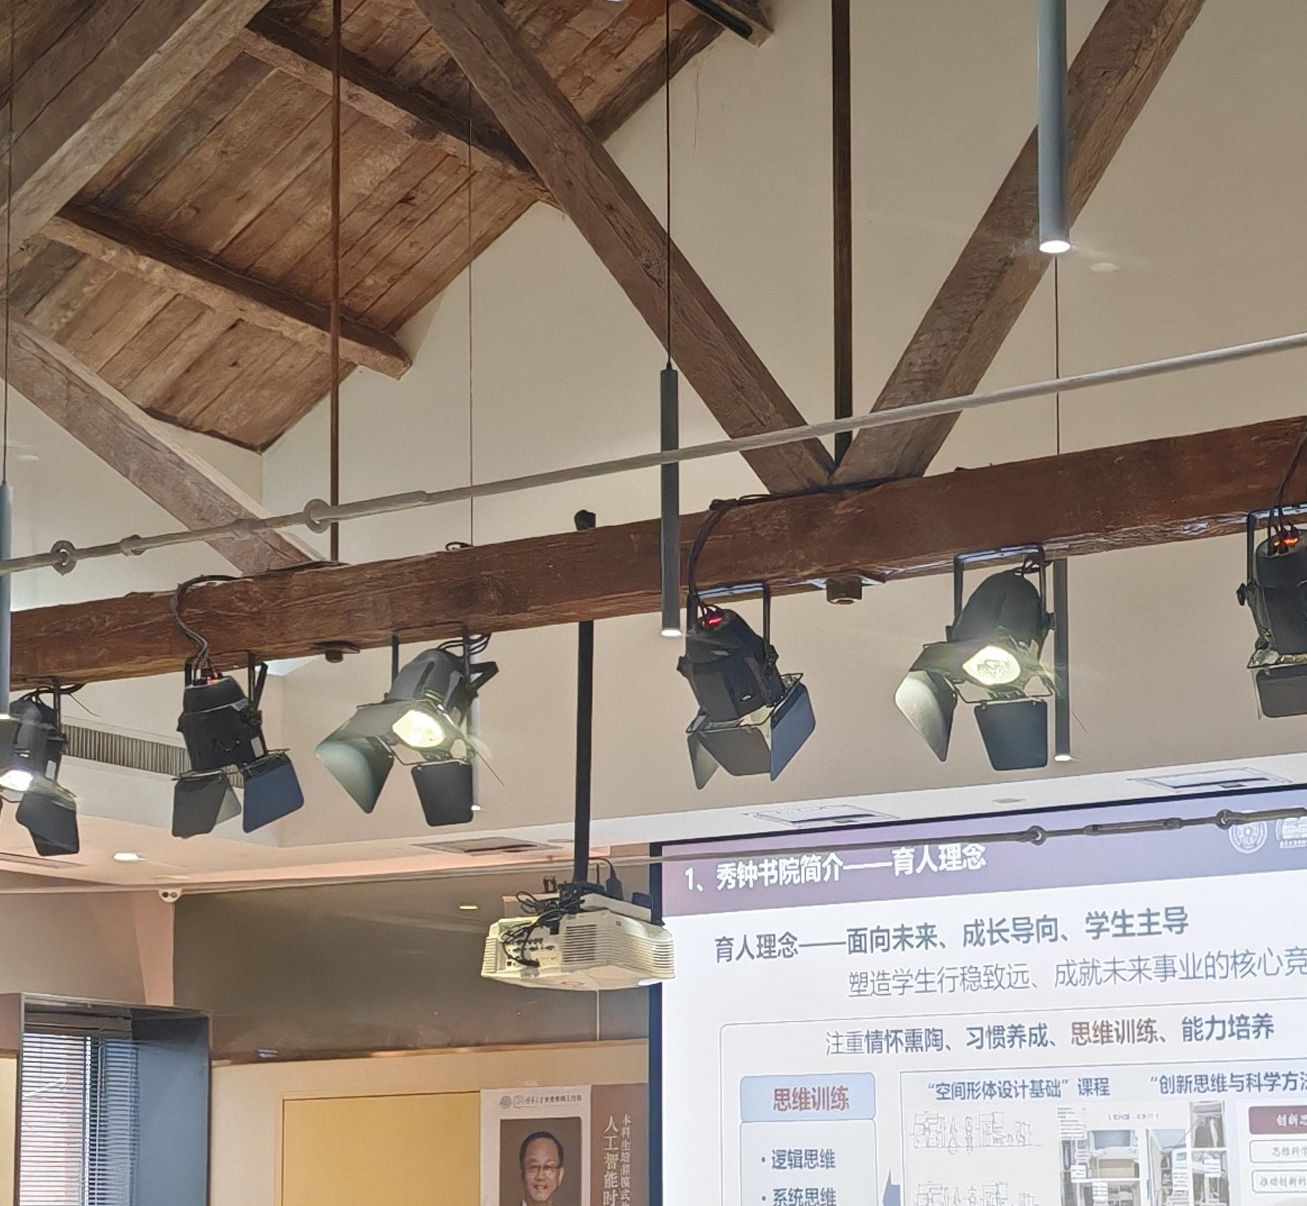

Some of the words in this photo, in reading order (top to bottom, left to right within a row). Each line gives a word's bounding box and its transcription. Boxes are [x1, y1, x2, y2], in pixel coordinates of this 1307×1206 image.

[825, 1013, 1275, 1056] 注重情怀熏陶、习惯养成、思维训练、能力培养
[773, 1085, 850, 1112] 思维训练
[771, 1149, 837, 1170] 逻辑思维
